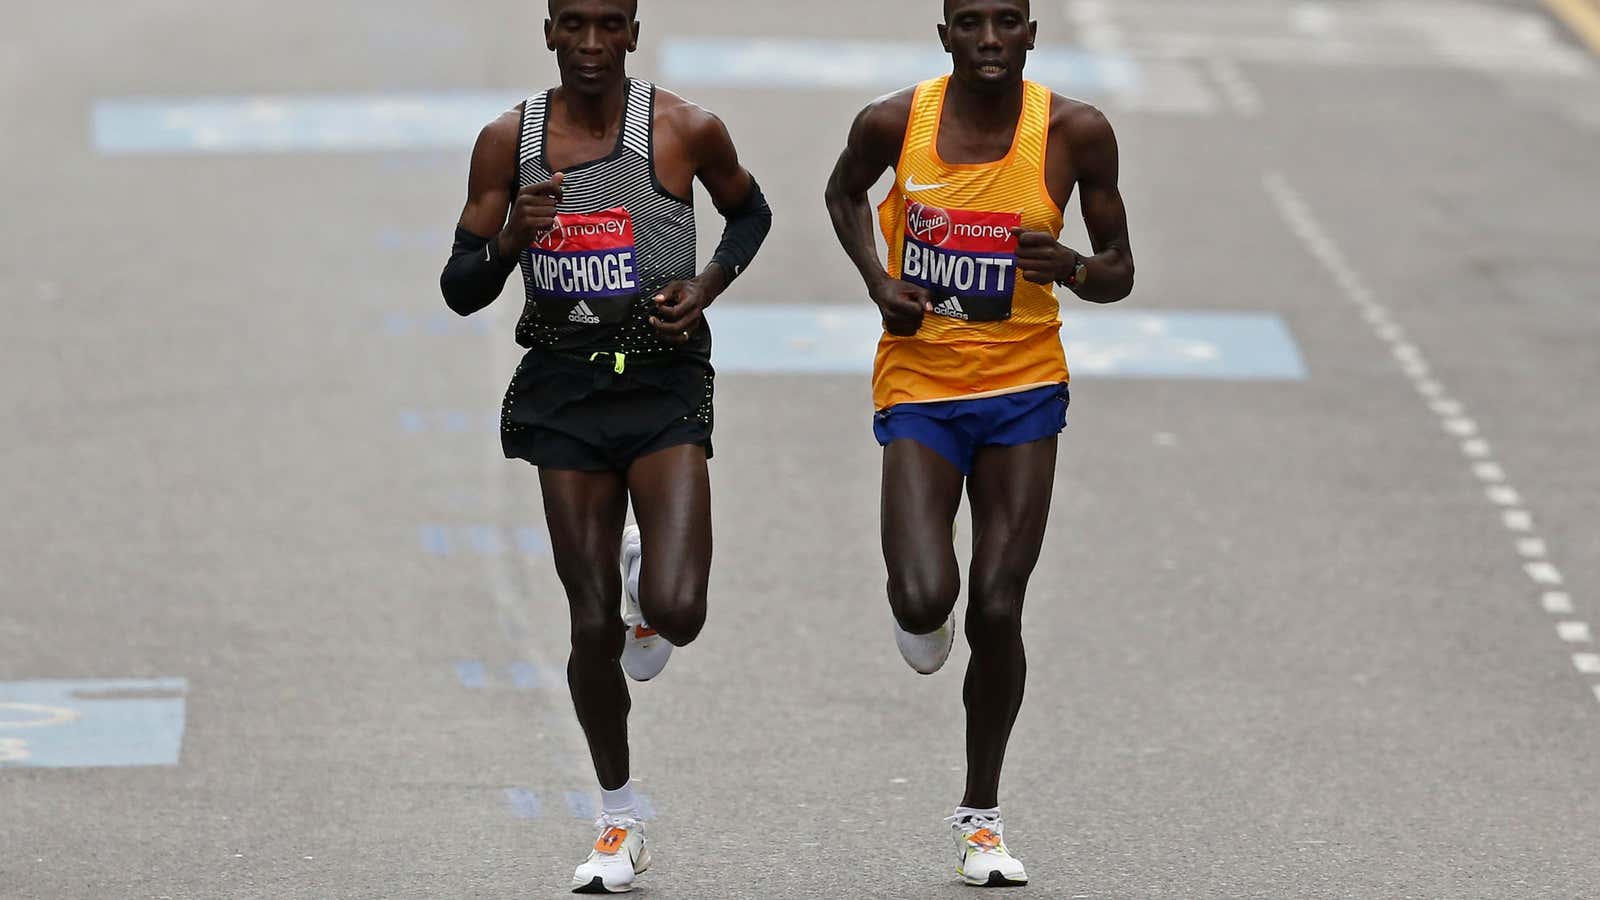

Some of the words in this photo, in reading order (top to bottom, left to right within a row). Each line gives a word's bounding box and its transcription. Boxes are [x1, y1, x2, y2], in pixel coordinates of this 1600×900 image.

[566, 219, 626, 236] money
[909, 205, 947, 241] Virgin
[953, 223, 1012, 242] money
[531, 252, 635, 293] KIPCHOGE
[903, 241, 1013, 291] BIWOTT
[568, 312, 600, 324] adidas
[934, 306, 969, 321] adidas
